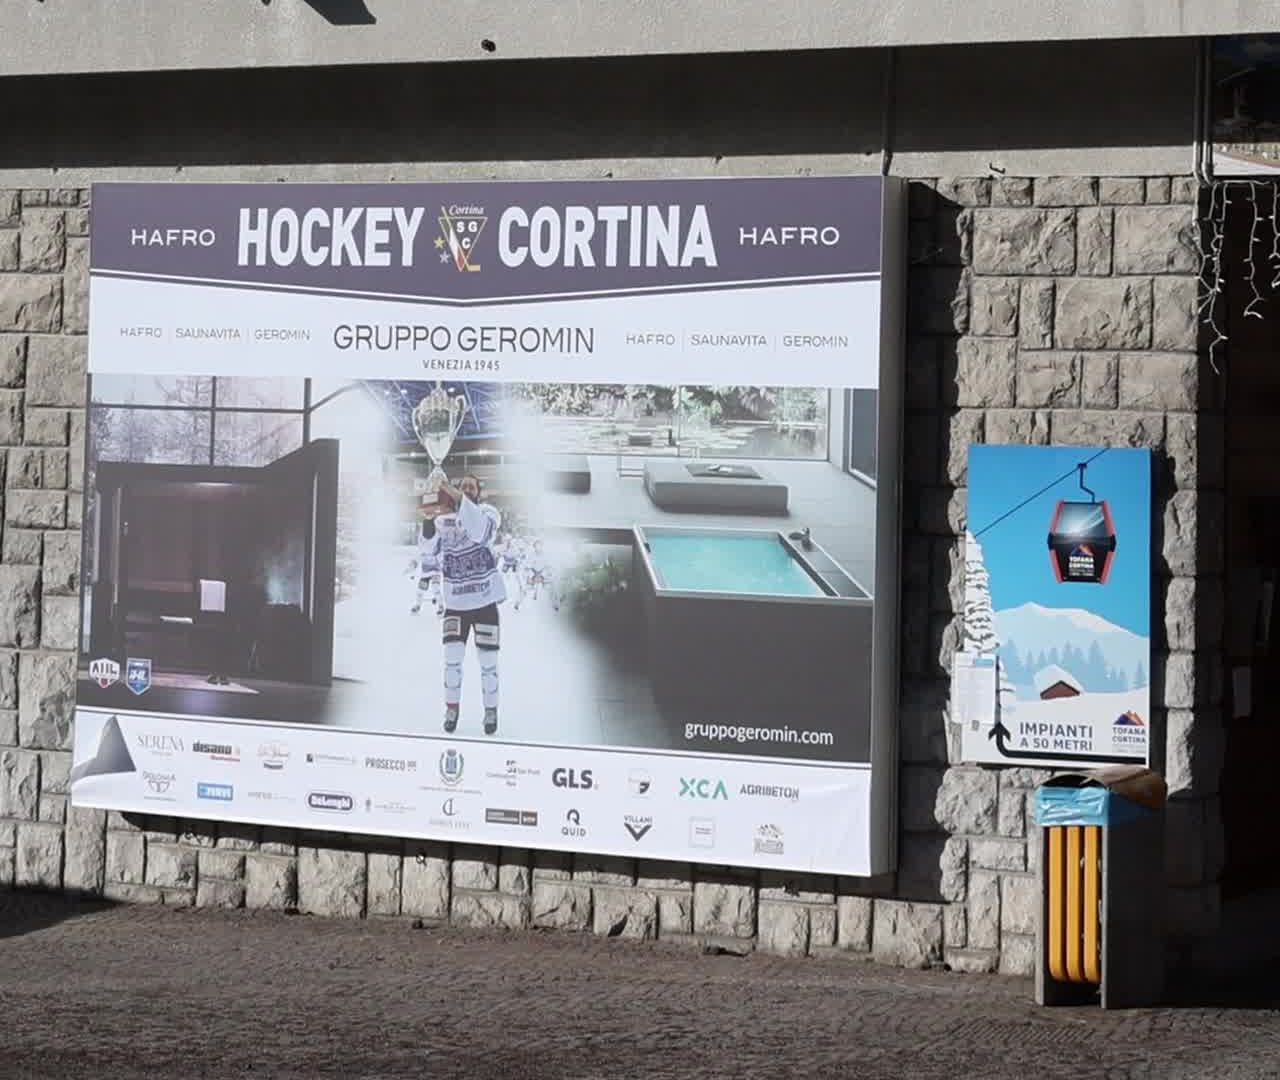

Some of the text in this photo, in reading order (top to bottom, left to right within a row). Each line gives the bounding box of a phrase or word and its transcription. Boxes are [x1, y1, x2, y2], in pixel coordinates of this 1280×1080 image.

[131, 204, 840, 268] HAFRO HOCKEY CORTINA HAFRO
[120, 327, 311, 341] HAFRO SAUNAVITA GEROMIN
[333, 324, 595, 353] GRUPPO GEROMIN
[625, 333, 849, 348] HAFRO SAUNAVITA GEROMIN
[422, 359, 501, 371] VENEZIA 1945
[684, 723, 834, 745] gruppogeromin.com
[1019, 722, 1093, 738] IMPIANTI
[1112, 727, 1146, 735] TOFANA
[1020, 738, 1029, 748] A
[1053, 739, 1093, 751] METRI
[1112, 736, 1146, 744] CORTINA
[365, 757, 405, 770] PROSECCO
[561, 826, 587, 837] QUID
